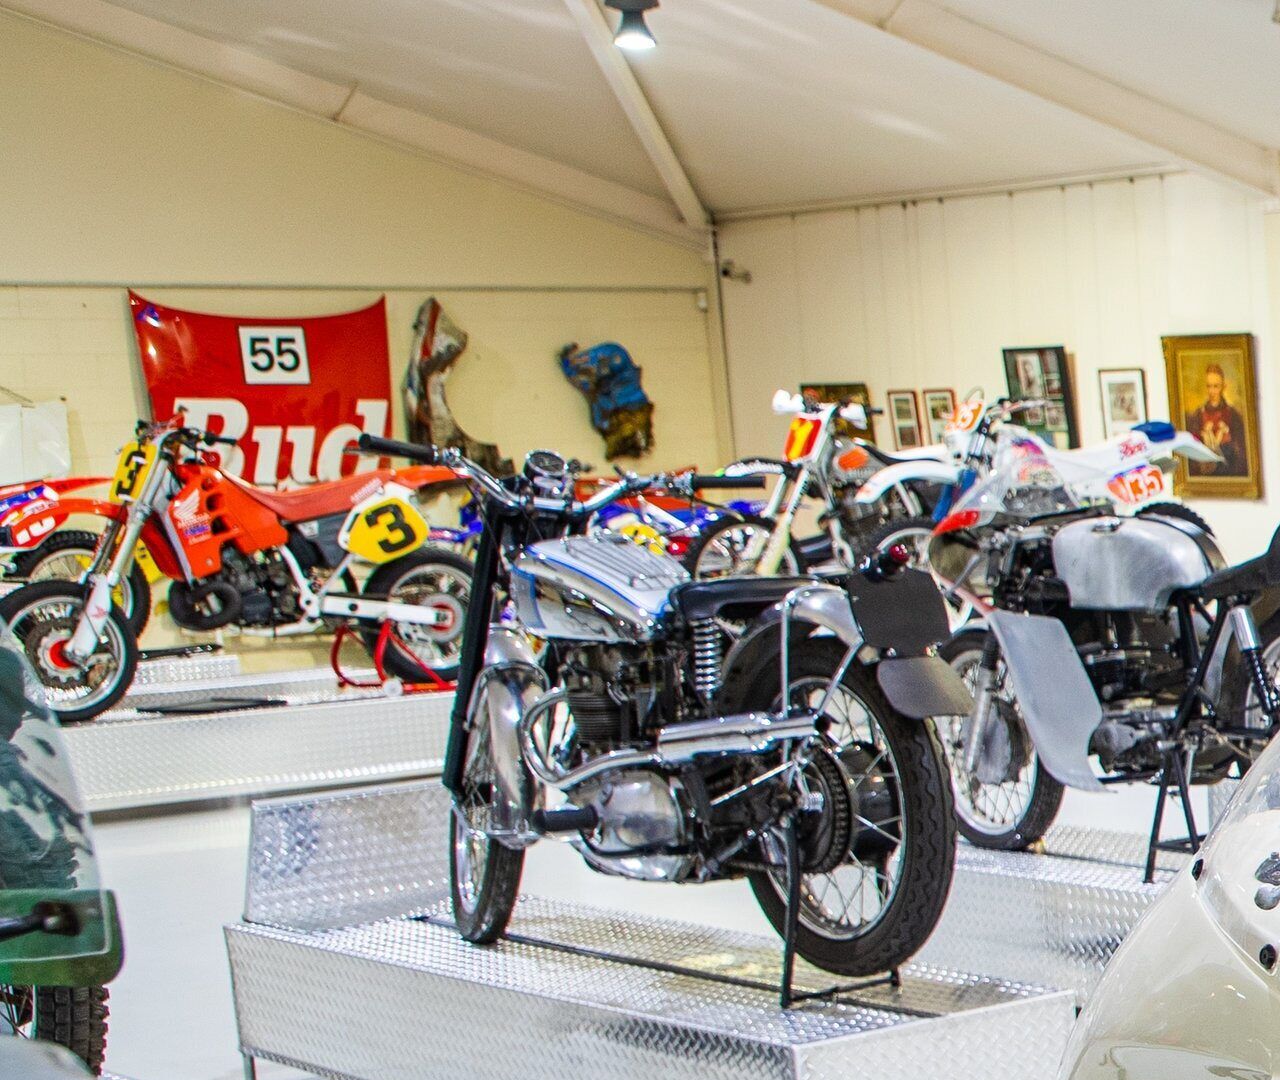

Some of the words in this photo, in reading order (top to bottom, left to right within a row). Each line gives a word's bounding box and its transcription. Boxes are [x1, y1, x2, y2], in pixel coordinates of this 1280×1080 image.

[250, 336, 300, 372] 55
[173, 397, 389, 488] Bud
[364, 503, 416, 554] 3
